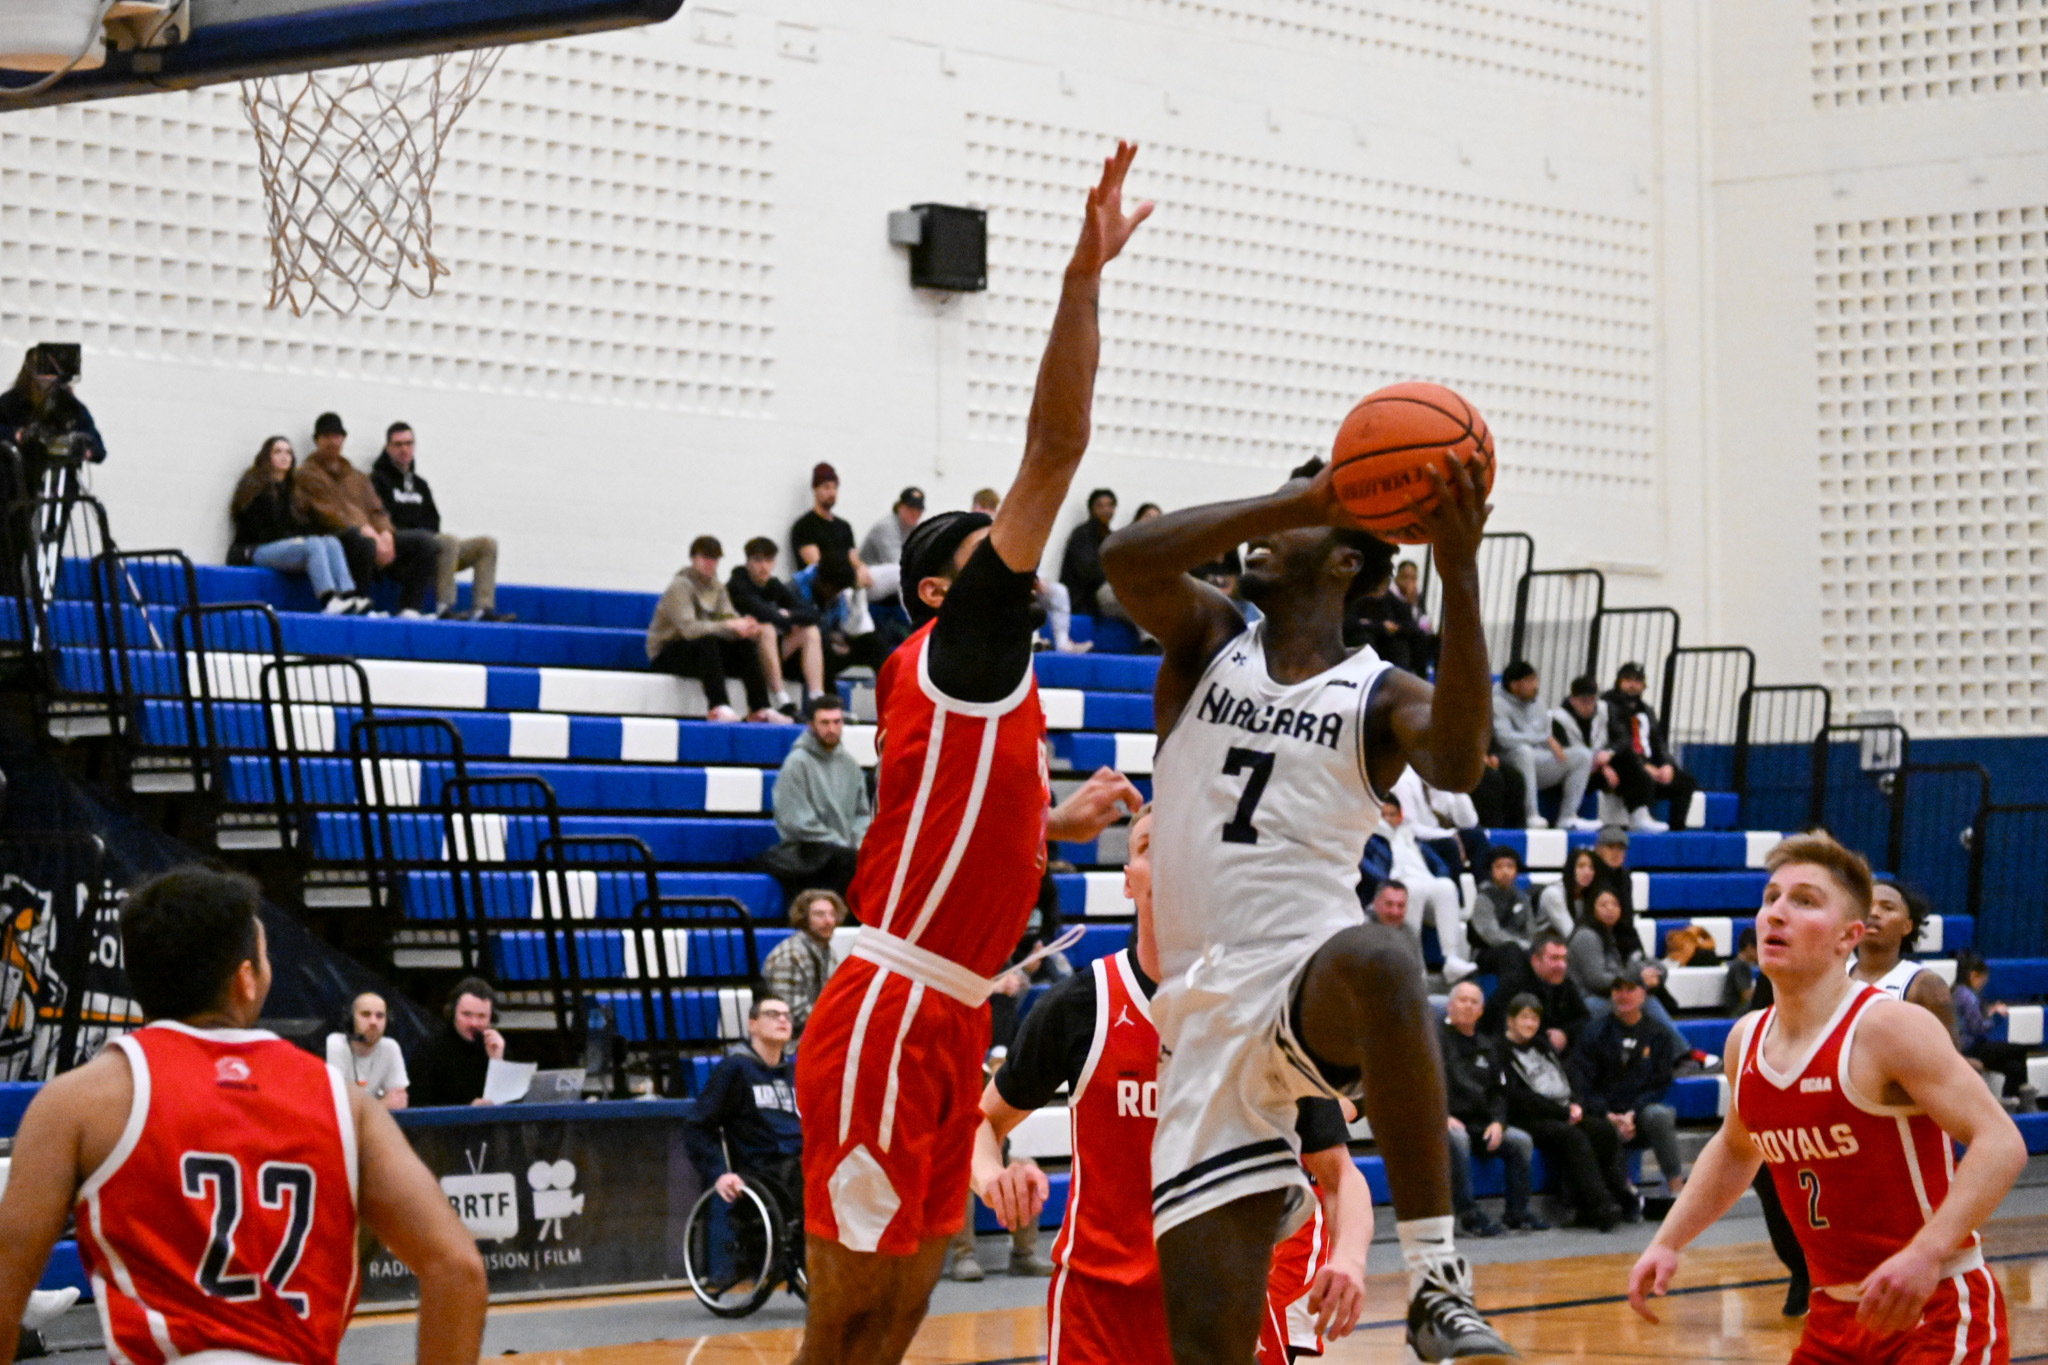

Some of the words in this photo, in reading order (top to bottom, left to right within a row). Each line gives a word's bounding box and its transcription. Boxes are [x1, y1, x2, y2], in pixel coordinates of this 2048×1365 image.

[1197, 682, 1343, 750] NIAGARA
[1222, 747, 1275, 844] 7
[1117, 1080, 1158, 1118] RO
[1798, 1169, 1830, 1230] 2
[180, 1150, 316, 1319] 22
[369, 1259, 410, 1278] RADI
[485, 1252, 530, 1270] ISION
[544, 1247, 582, 1265] FILM
